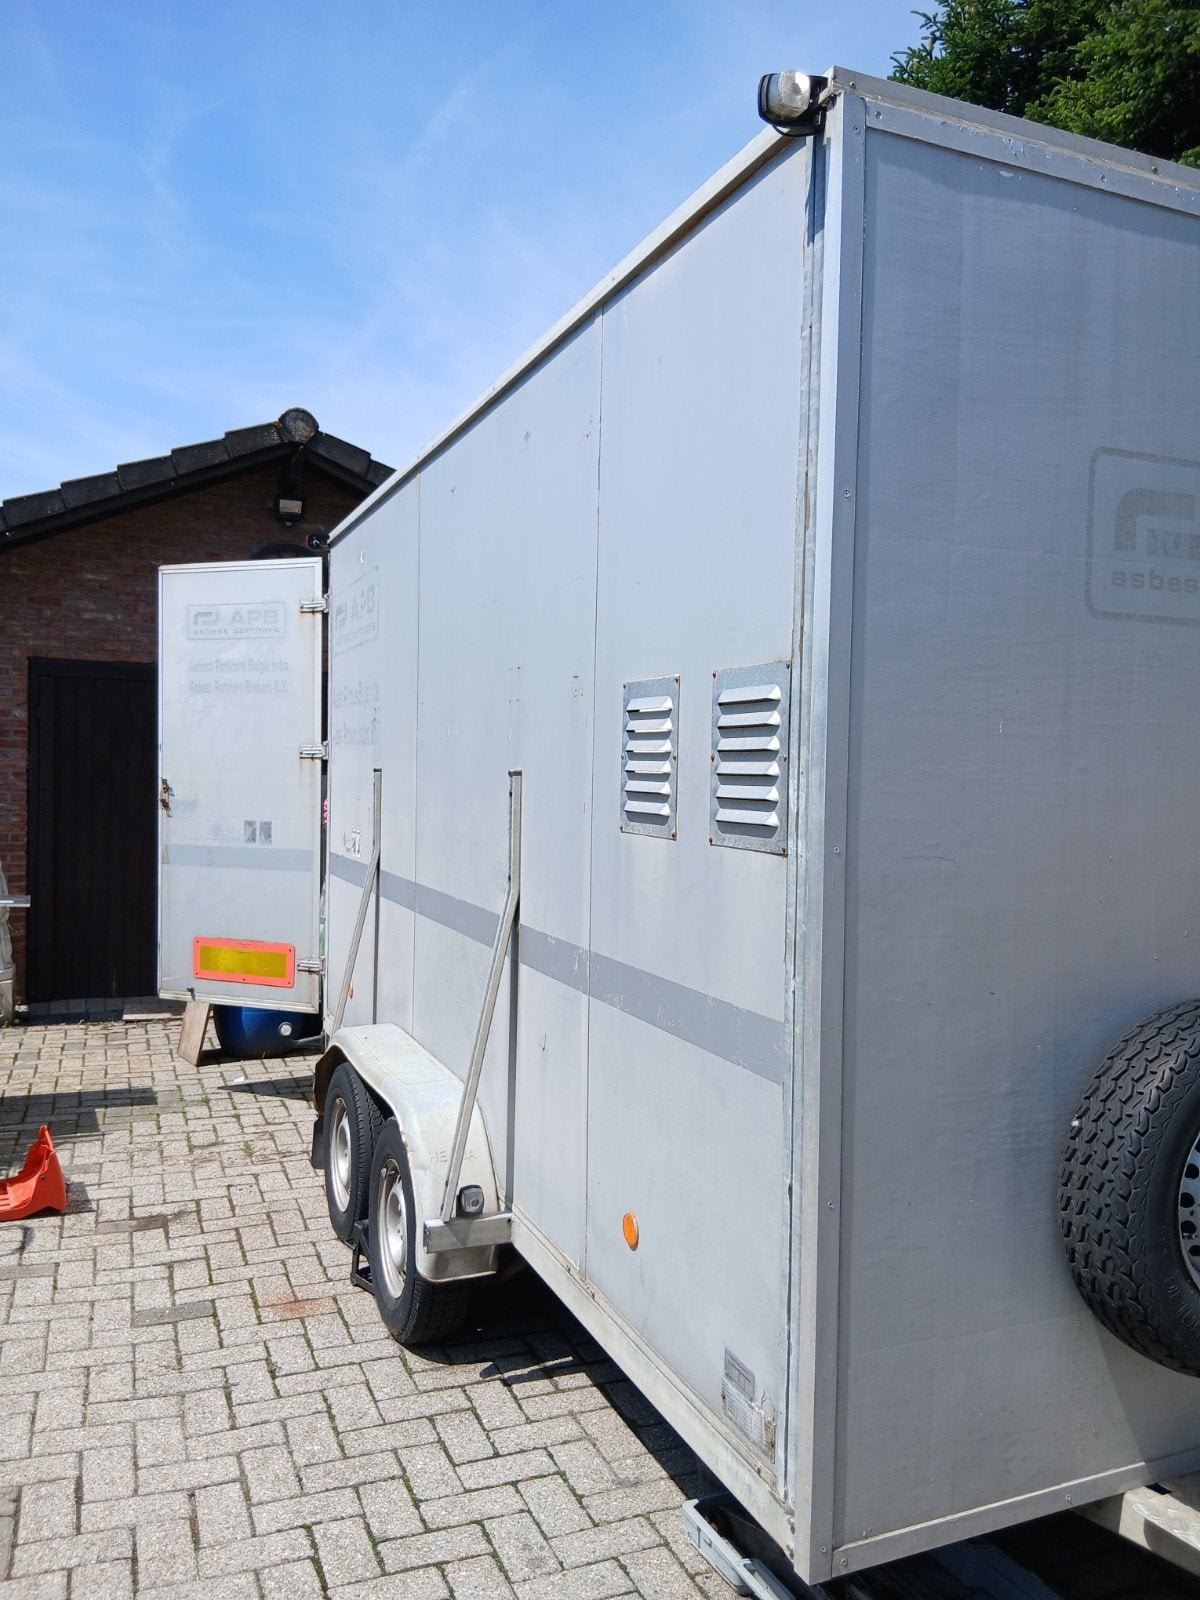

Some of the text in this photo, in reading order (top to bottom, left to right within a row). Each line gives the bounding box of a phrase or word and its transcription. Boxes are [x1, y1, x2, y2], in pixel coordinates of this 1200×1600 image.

[230, 609, 279, 625] APB
[193, 627, 228, 635] asbest
[232, 626, 280, 635] partners
